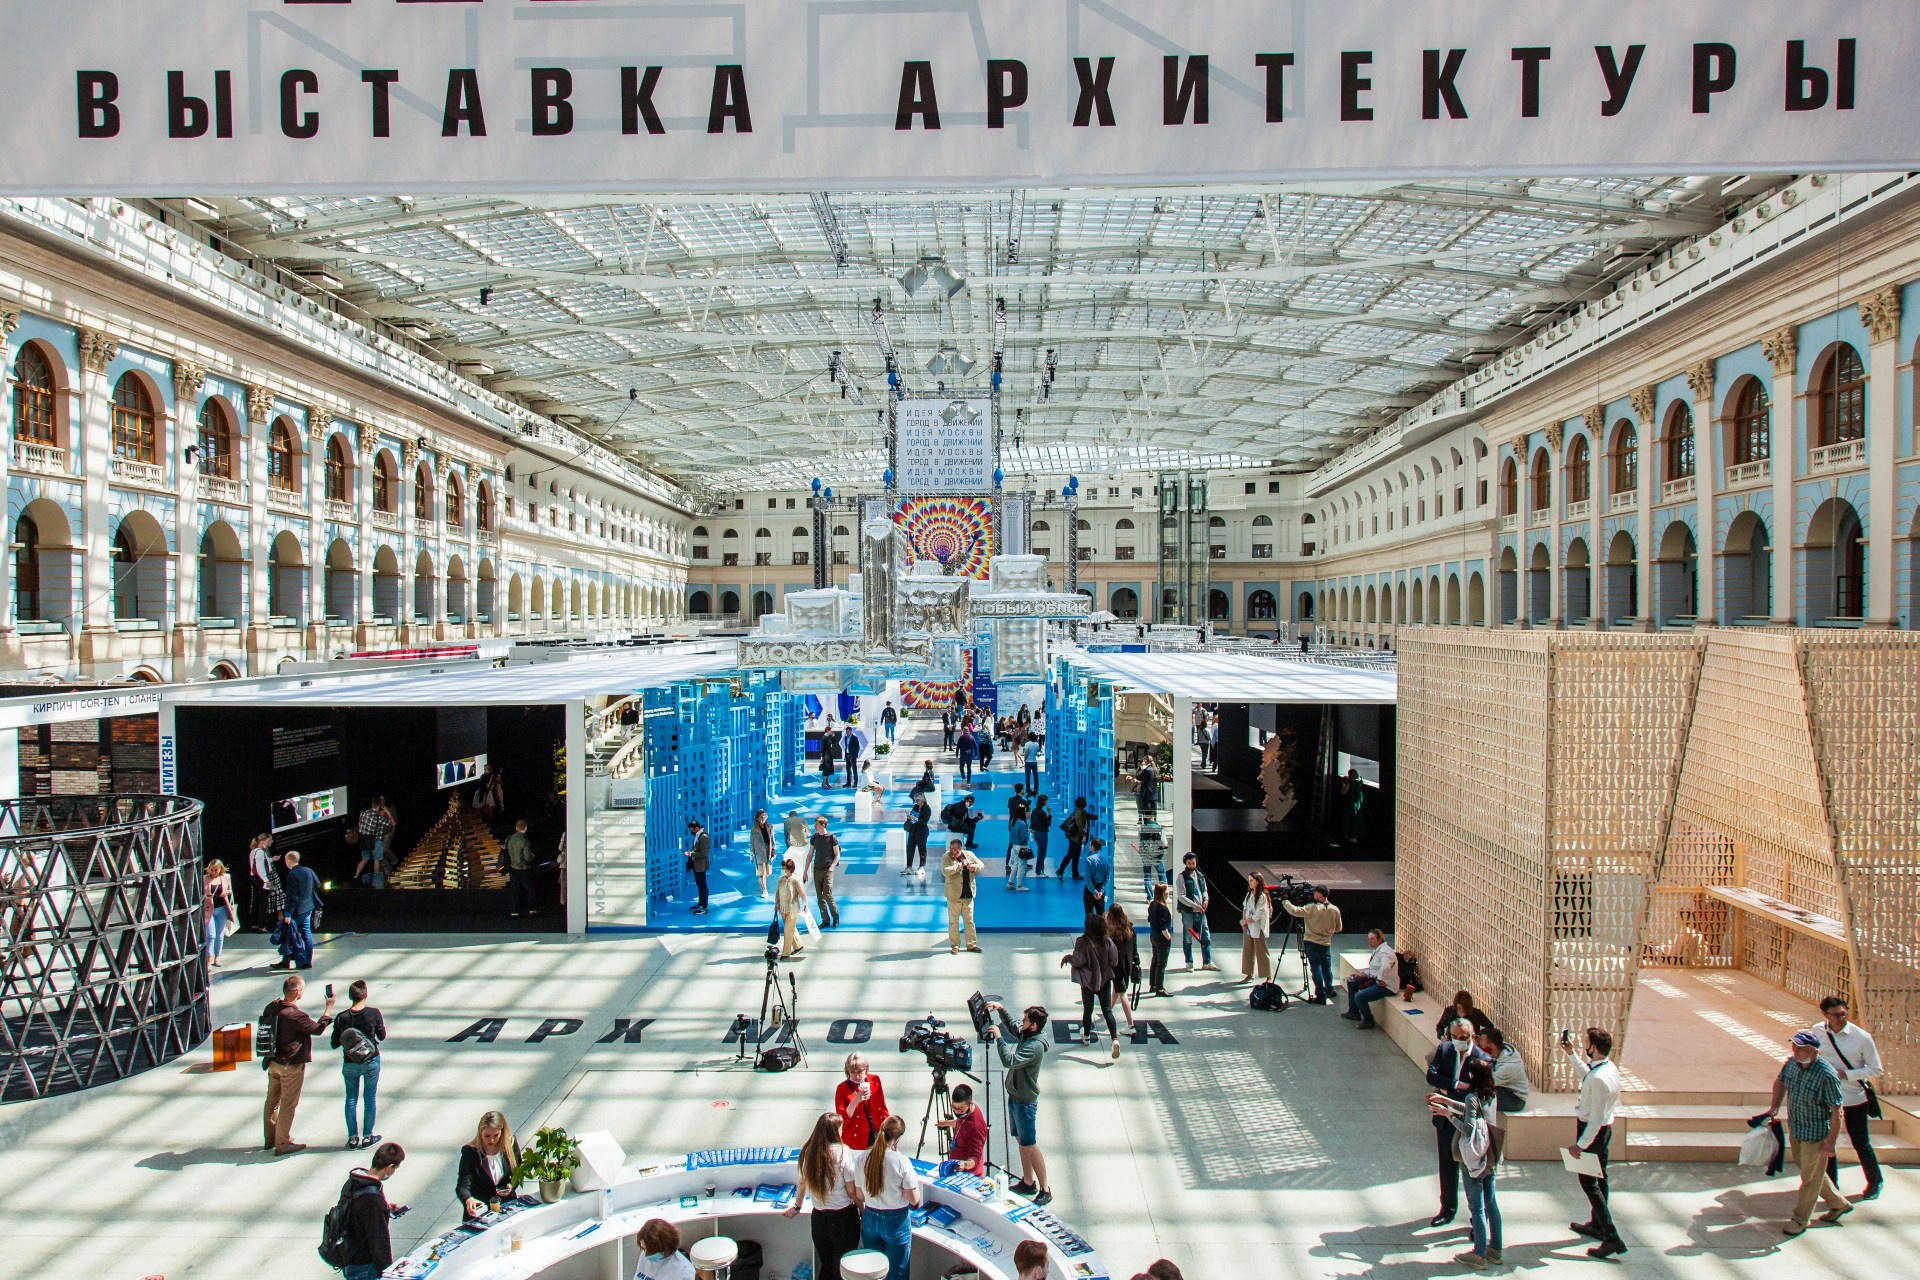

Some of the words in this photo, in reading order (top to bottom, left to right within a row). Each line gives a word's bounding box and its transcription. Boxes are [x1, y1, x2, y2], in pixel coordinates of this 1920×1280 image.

[76, 64, 753, 140] ВЫСТАВКА
[895, 38, 1857, 131] АРХИТЕКТУРЫ
[907, 409, 933, 417] ИДЕЯ
[907, 419, 929, 427] ГОРОД
[907, 429, 933, 437] ИДЕЯ
[907, 439, 929, 447] ГОРОД
[943, 439, 983, 447] ДВИЖЕНИИ
[939, 448, 983, 456] МОСКВЫ
[944, 458, 983, 466] ДВИЖЕНИИ
[907, 468, 933, 476] ИДЕЯ
[944, 478, 983, 486] ДВИЖЕНИИ
[973, 601, 1033, 614] НОВЫЙ
[1035, 600, 1089, 614] ОБЛИК
[745, 643, 865, 662] МОСКВА
[33, 702, 73, 714] КИРПИЧ
[80, 696, 120, 709] COR-TEN
[161, 735, 174, 796] НТИТЕЗЫ
[444, 1017, 657, 1044] АРХ
